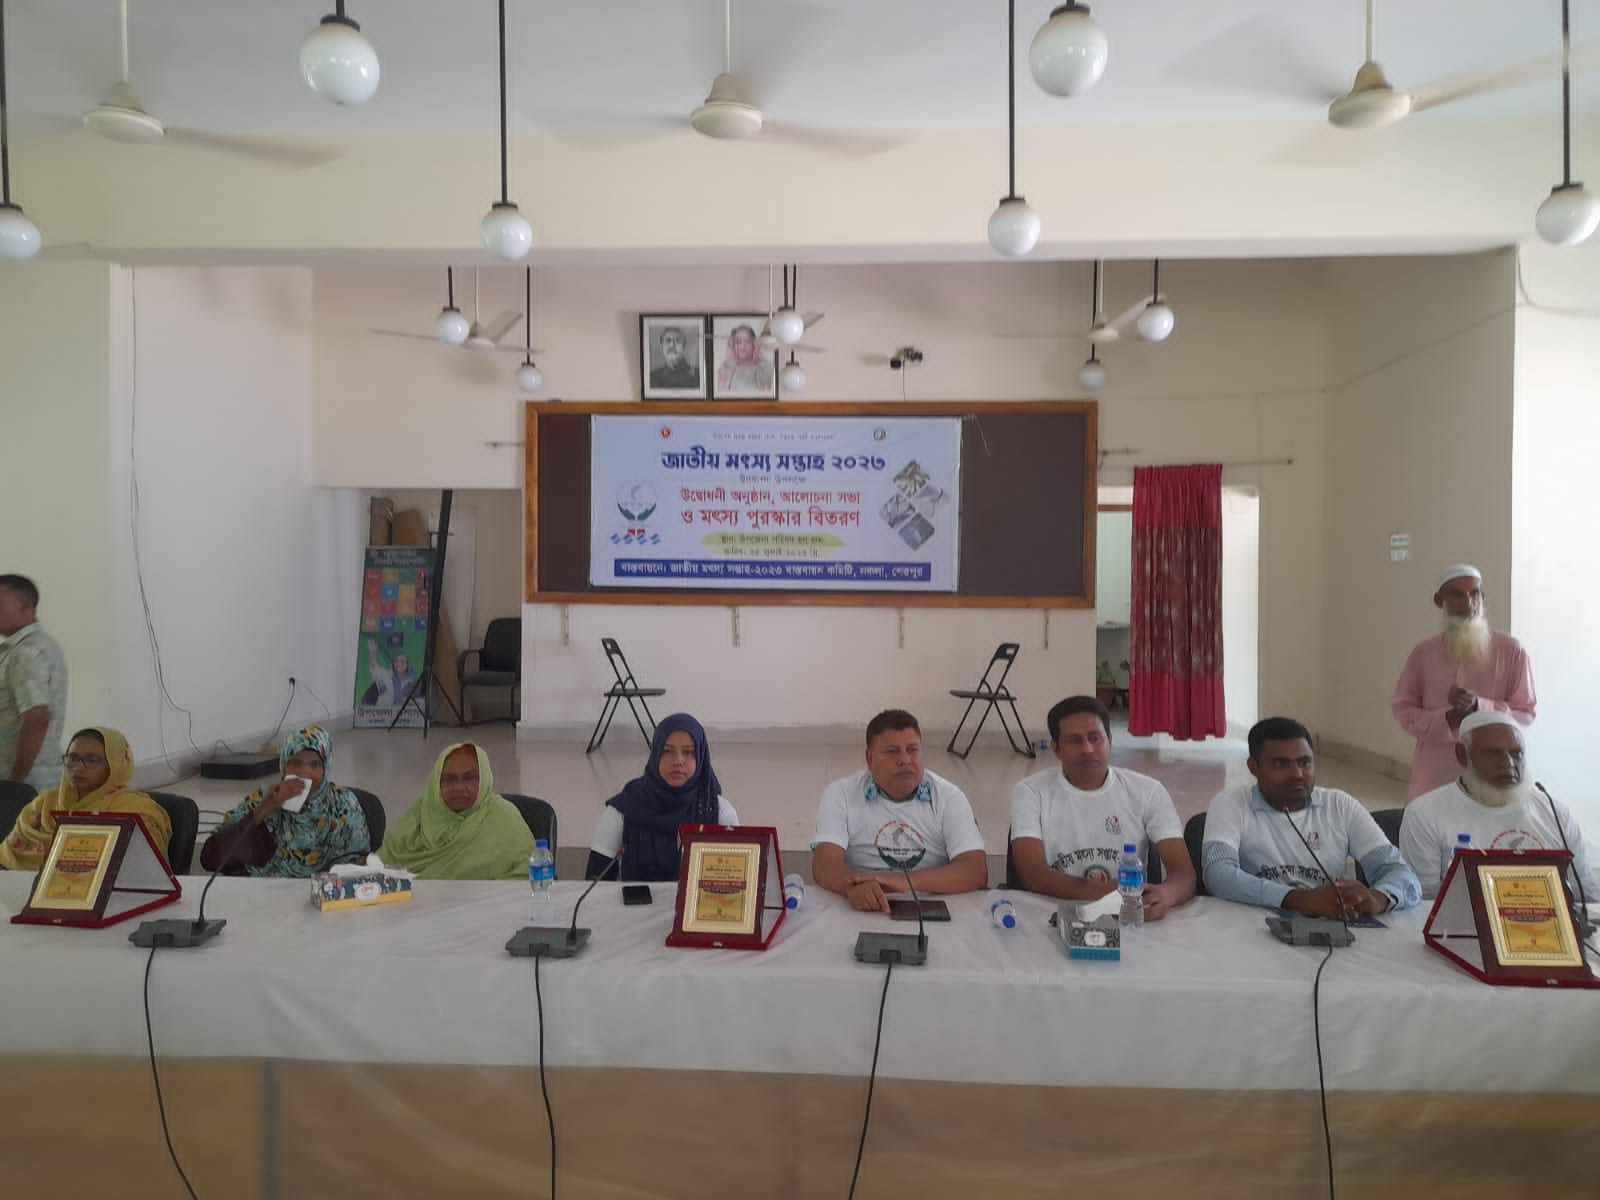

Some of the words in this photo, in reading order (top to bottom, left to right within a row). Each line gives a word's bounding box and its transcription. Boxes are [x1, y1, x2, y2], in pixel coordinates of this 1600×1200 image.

[661, 445, 720, 470] জাতীয়
[726, 453, 771, 472] মৎস্য
[776, 453, 825, 472] সপ্তাহ
[832, 455, 886, 470] ২০২৩
[681, 511, 694, 524] ও
[700, 510, 739, 526] মৎস্য
[747, 510, 801, 529] পুরস্কার
[808, 505, 860, 528] বিতরণ
